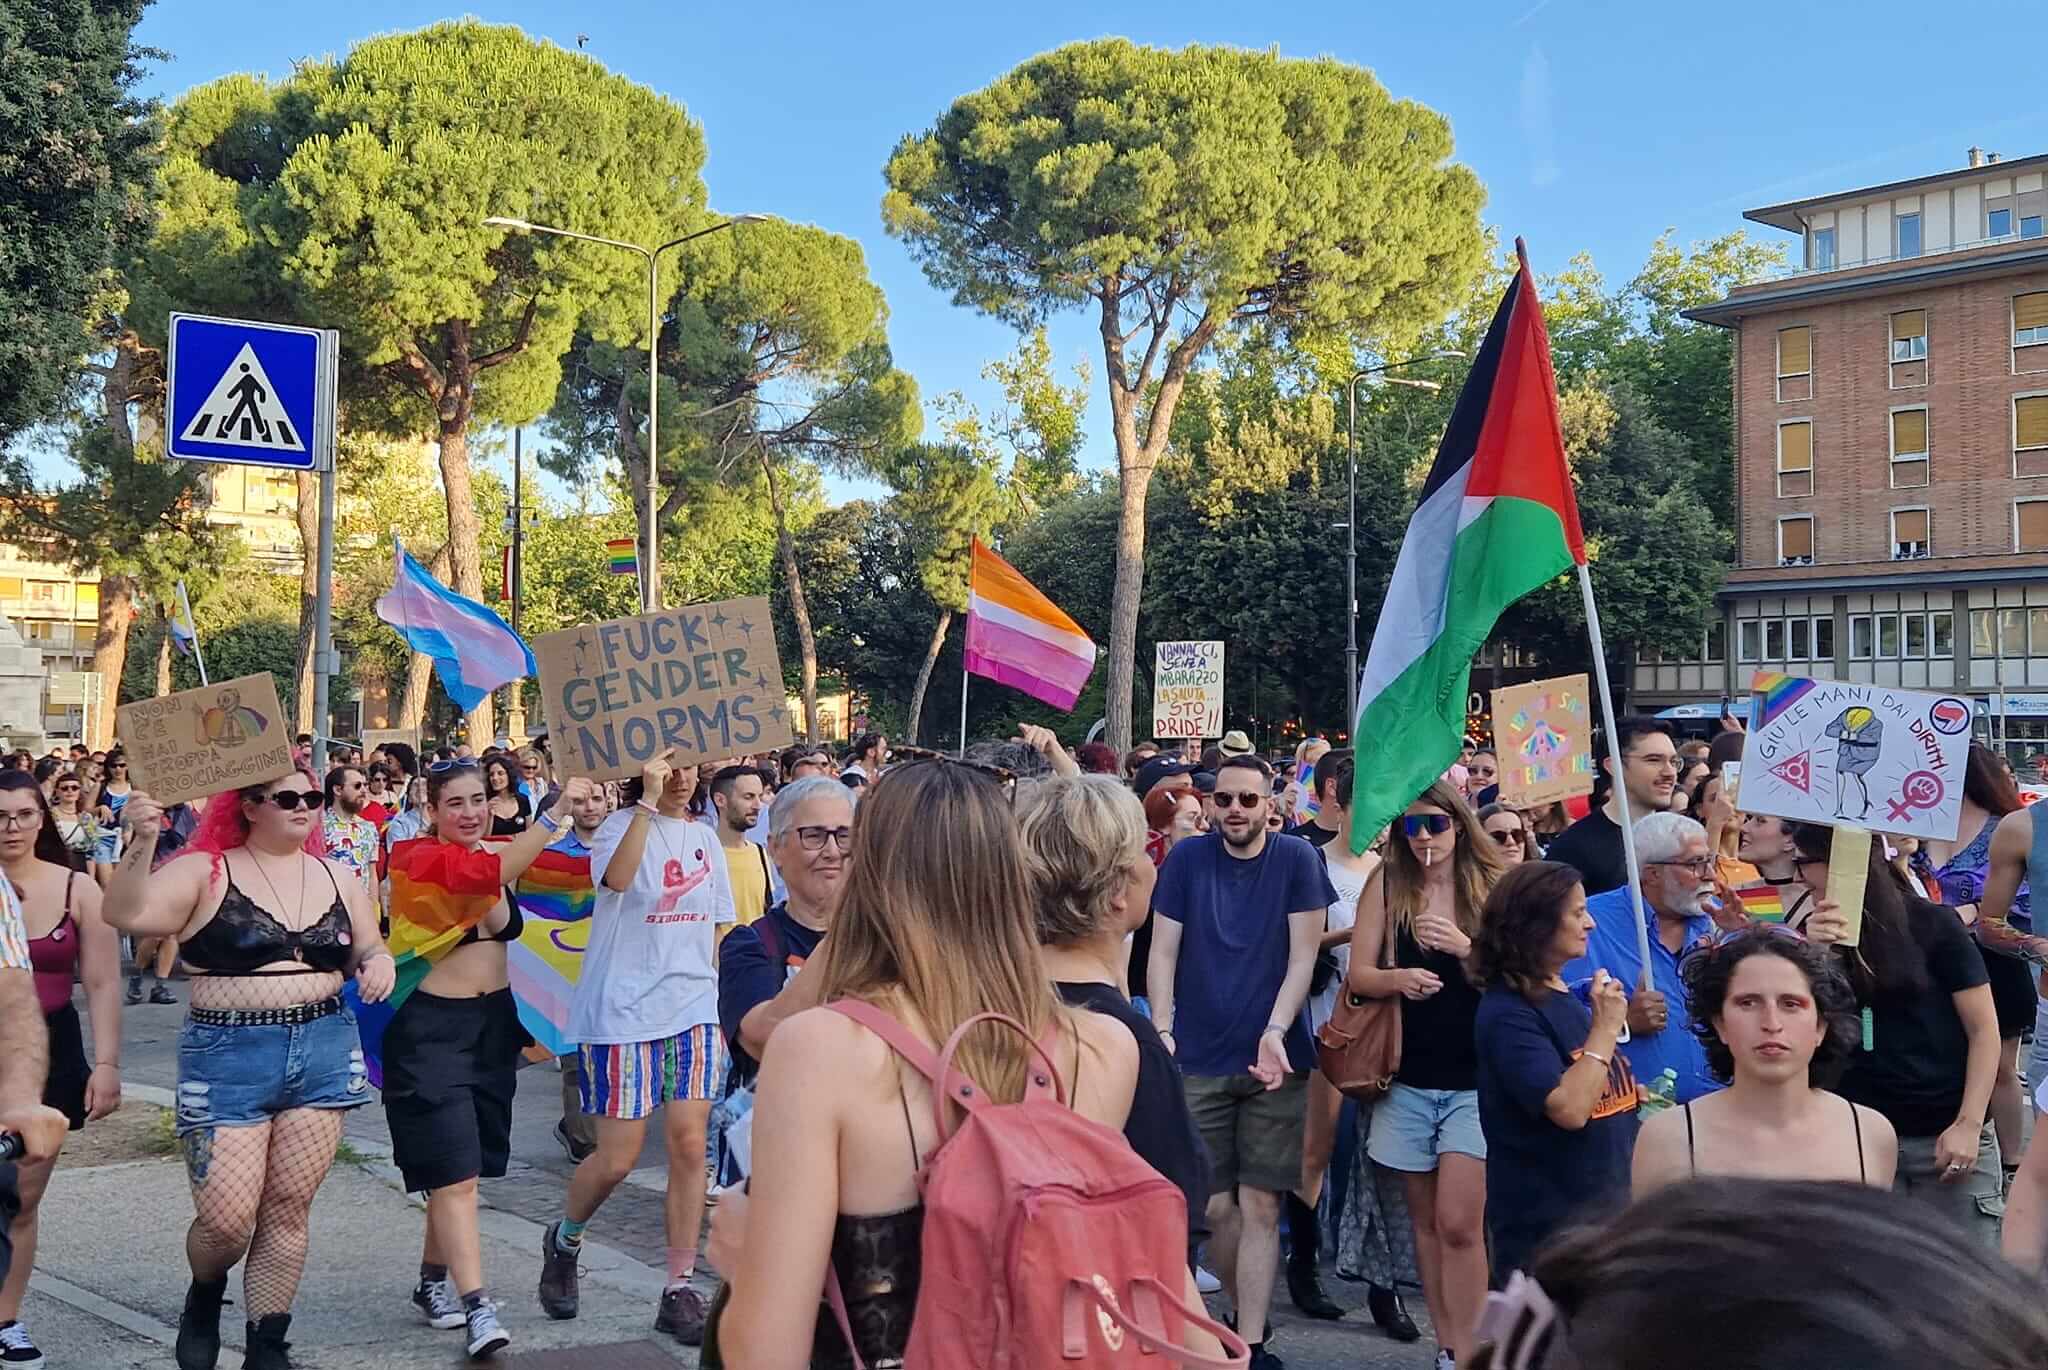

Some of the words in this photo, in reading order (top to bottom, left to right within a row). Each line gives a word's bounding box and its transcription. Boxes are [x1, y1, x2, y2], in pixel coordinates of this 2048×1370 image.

[599, 614, 709, 669] FUCK
[1162, 657, 1207, 671] SENZA
[562, 648, 752, 722] GENDER
[1785, 703, 1809, 725] LE
[1814, 687, 1872, 709] MANI
[1881, 693, 1909, 719] DAI
[1169, 701, 1205, 716] STO
[577, 695, 760, 771] NORMS
